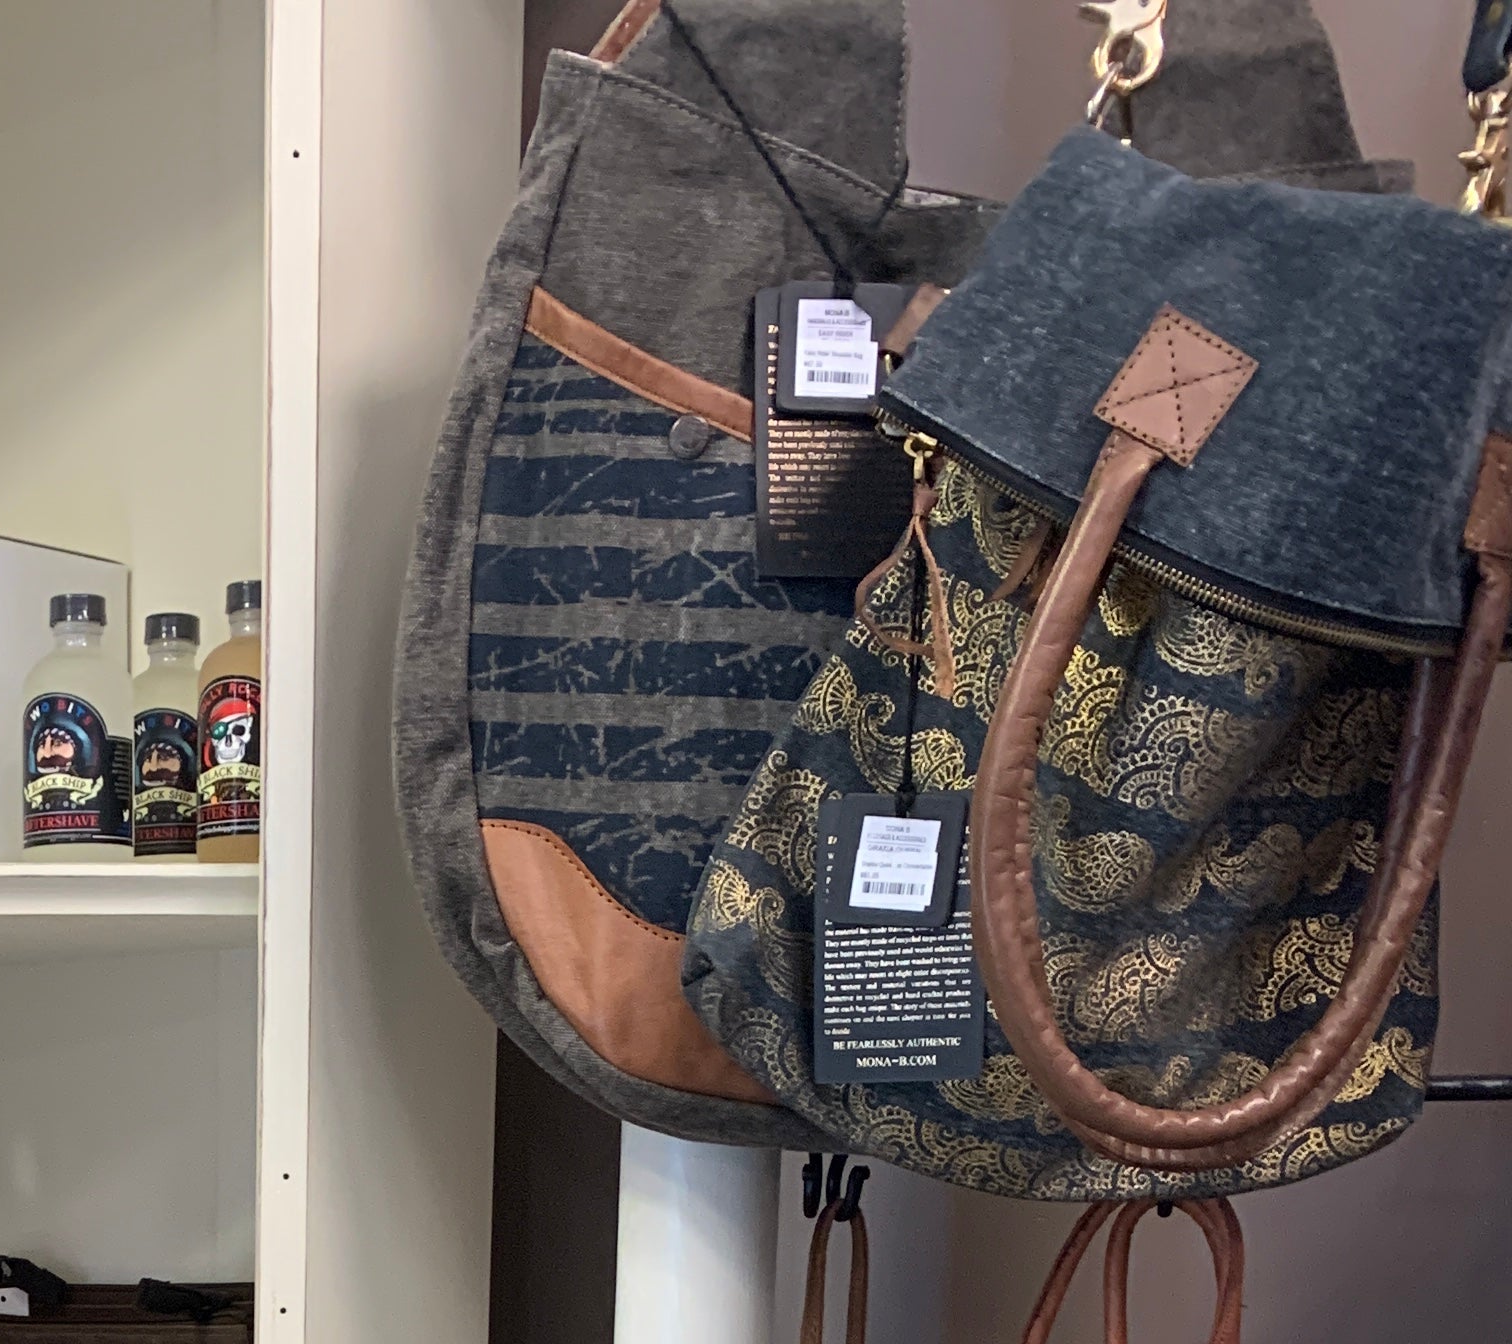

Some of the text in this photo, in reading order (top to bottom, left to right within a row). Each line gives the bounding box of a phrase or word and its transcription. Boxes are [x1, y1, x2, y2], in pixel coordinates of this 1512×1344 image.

[135, 715, 156, 736] WO
[203, 766, 232, 785] BLACK
[31, 777, 87, 793] BLACK SHIP
[169, 789, 193, 801] SHIP
[139, 826, 196, 841] TERSHAV
[833, 1036, 961, 1051] BE FEARLESSLY AUTHENTIC
[856, 1054, 937, 1068] MONA-B.COM
